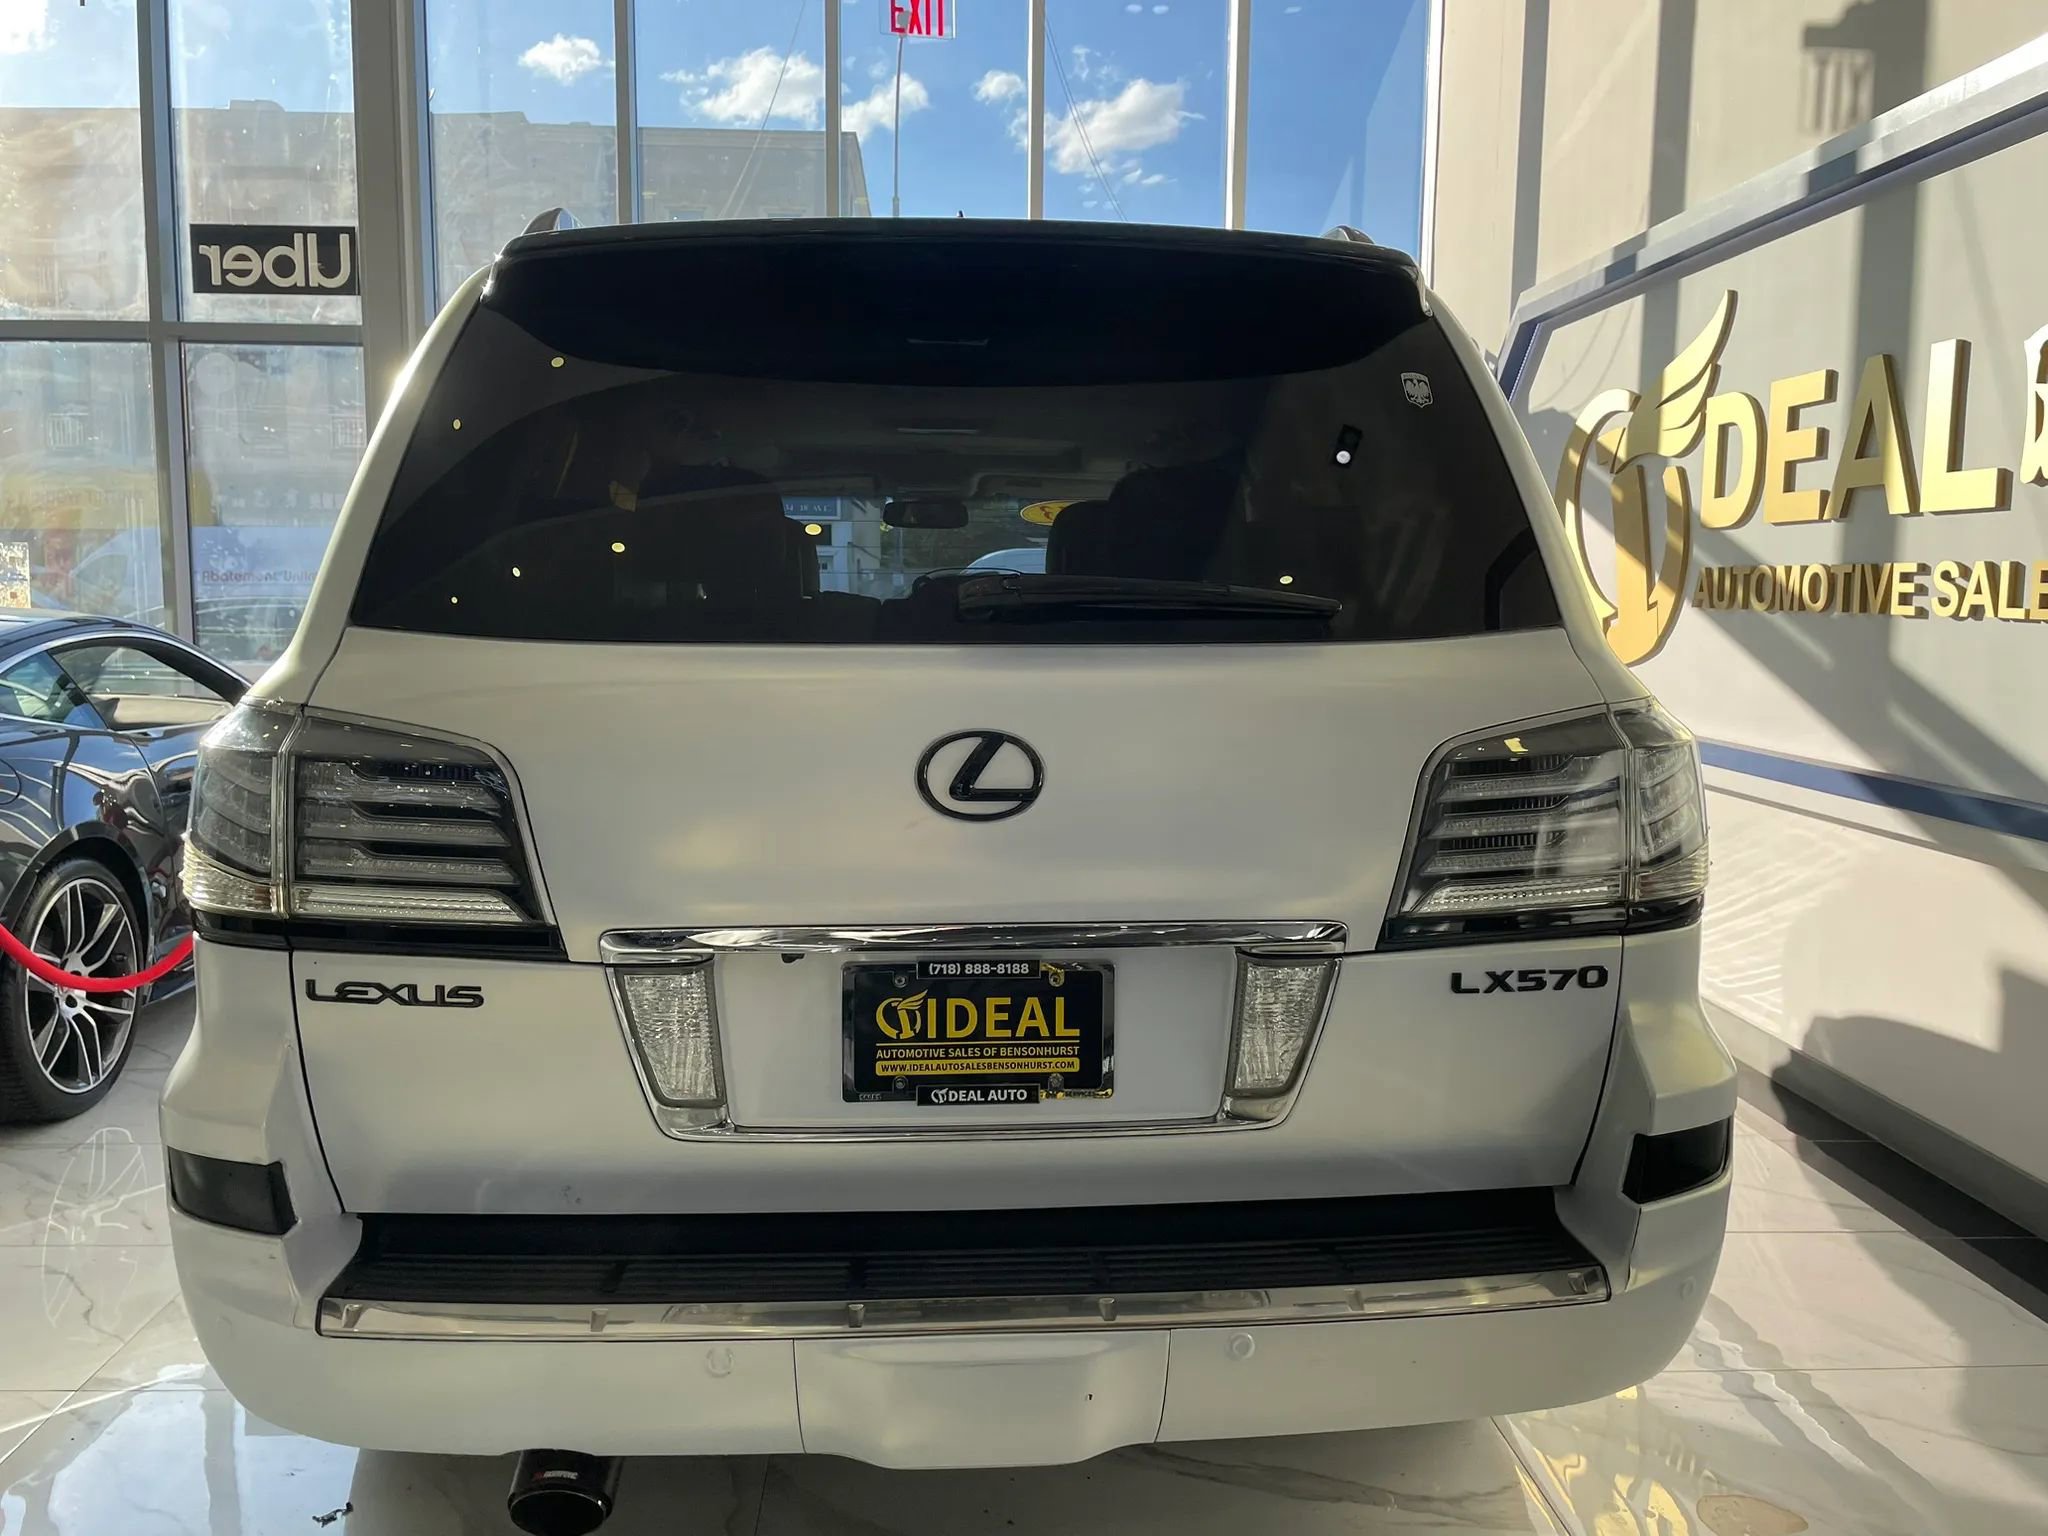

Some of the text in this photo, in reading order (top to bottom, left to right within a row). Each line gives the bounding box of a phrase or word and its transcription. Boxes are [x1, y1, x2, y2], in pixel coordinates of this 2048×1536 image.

[1690, 560, 1931, 620] AUTOMOTIVE
[928, 962, 1030, 976] (718) 888-8188
[1450, 965, 1609, 994] LX570
[305, 978, 485, 1009] LEXUS
[926, 996, 1081, 1039] IDEAL
[876, 1045, 1080, 1060] AUTOMOTIVE SALES OF BENSONHURST
[880, 1060, 1076, 1073] WWW.IDEALAUTOSALESBENSONHURST.COM
[987, 1088, 1028, 1101] AUTO
